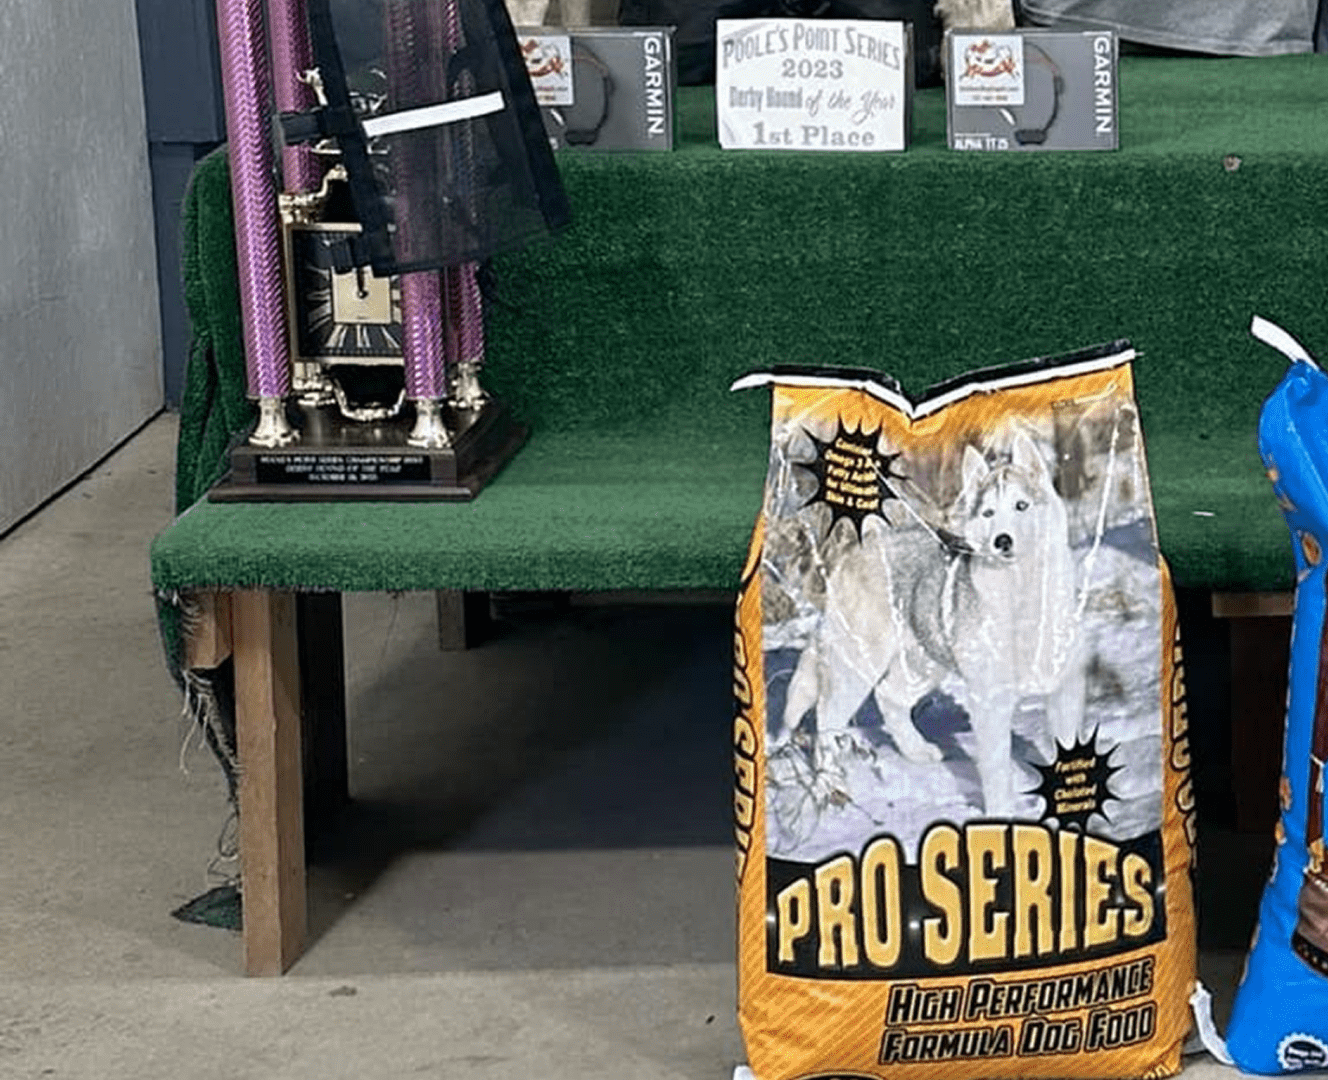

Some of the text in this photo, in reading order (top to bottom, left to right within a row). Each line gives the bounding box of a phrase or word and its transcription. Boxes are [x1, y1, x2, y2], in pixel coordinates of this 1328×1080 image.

[723, 22, 900, 71] POOLE'S POINT SERIES
[782, 58, 843, 79] 2023
[643, 36, 665, 136] GARMIN
[805, 89, 823, 118] of
[827, 89, 852, 110] the
[852, 89, 896, 126] Year
[1093, 36, 1112, 134] GARMIN
[752, 121, 875, 147] 1st Place
[777, 824, 1154, 968] PRO SERIES
[888, 958, 1155, 1025] HIGH PERFORMANCE
[880, 1003, 1156, 1064] FORMULA DOG FOOD
